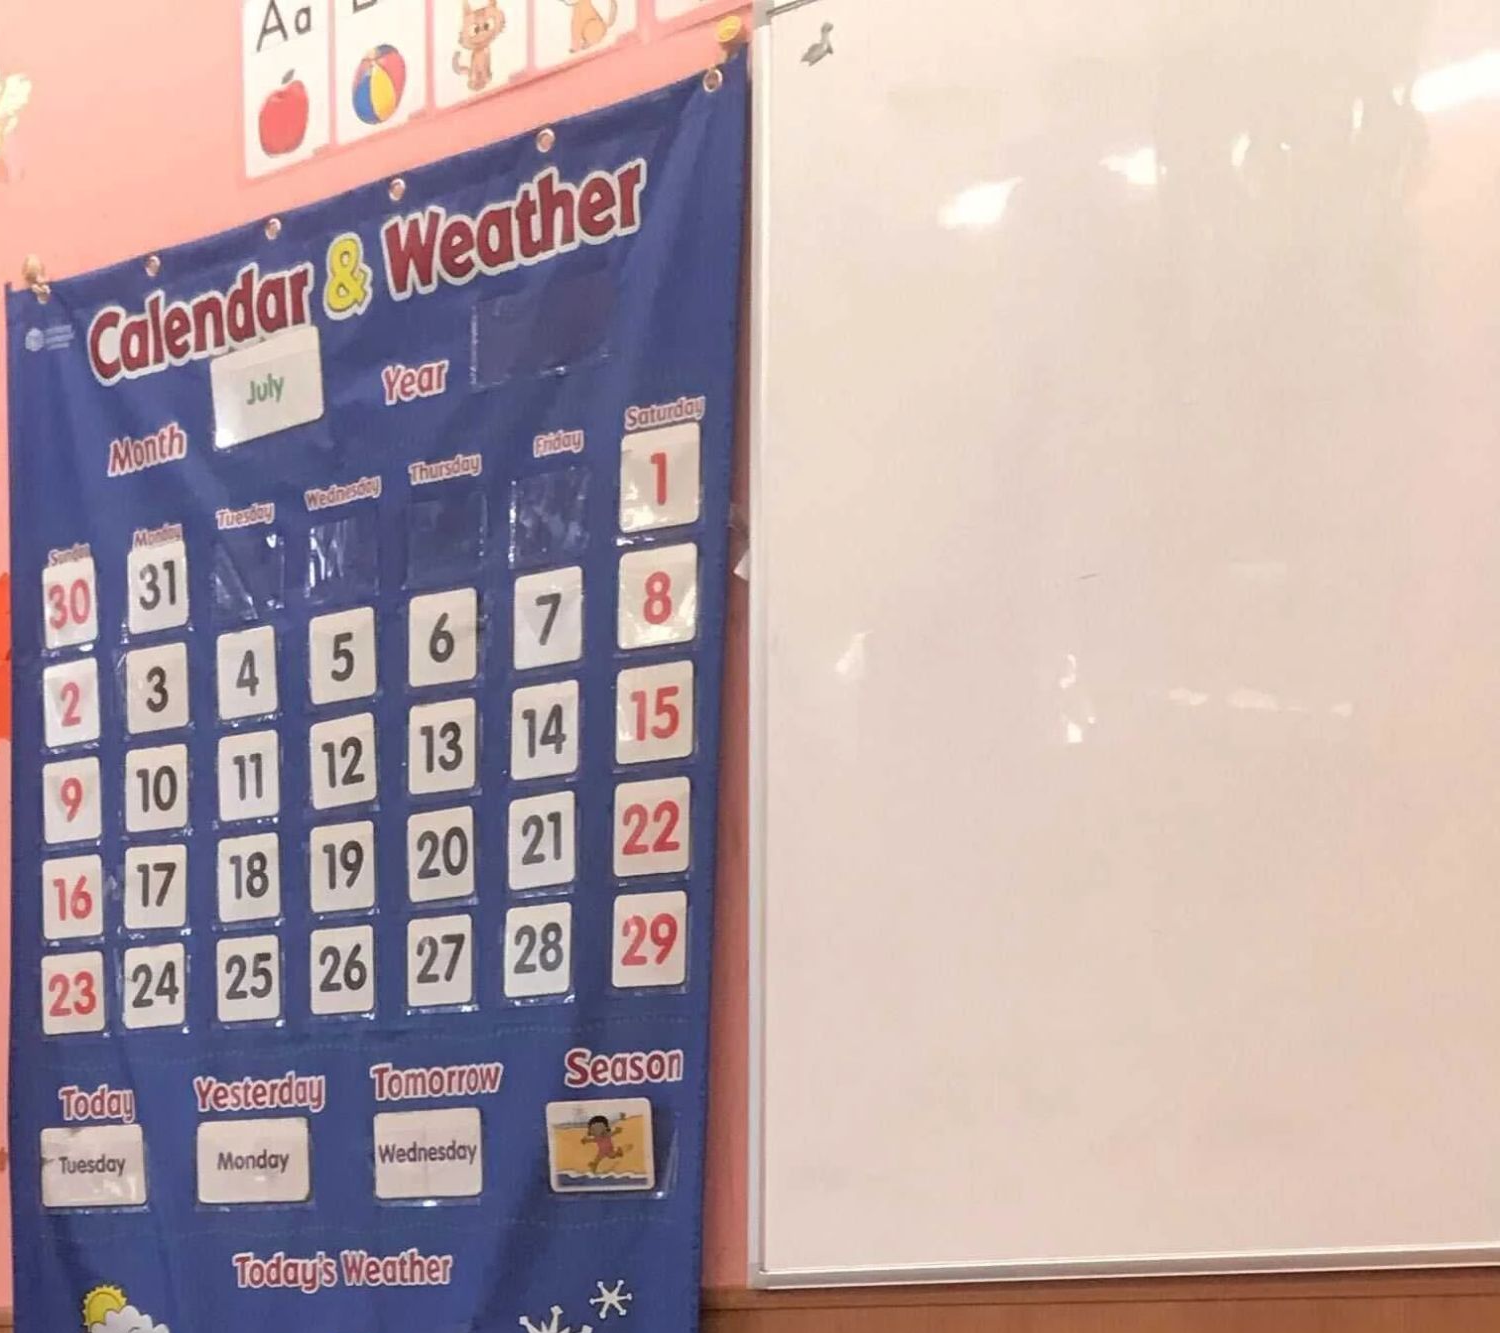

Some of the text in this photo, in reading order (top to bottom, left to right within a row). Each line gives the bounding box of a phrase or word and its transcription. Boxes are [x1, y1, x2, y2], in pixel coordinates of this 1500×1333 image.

[88, 160, 647, 385] Calendar & Weather
[246, 374, 284, 405] July
[382, 360, 449, 404] Year
[108, 426, 185, 477] Month
[216, 502, 274, 530] Tuesday
[305, 476, 382, 511] Wednesday
[409, 454, 481, 485] Thursday
[533, 430, 583, 457] Friday
[625, 395, 706, 430] Saturday
[48, 453, 667, 630] 30 31 1
[60, 572, 672, 726] 2 3 4 5 6 7 8
[61, 686, 679, 821] 9 10 11 12 13 14 15
[54, 801, 680, 920] 16 17 18 19 20 21 22
[49, 913, 677, 1016] 23 24 25 26 27 28 29
[59, 1048, 684, 1123] Today Yesterday Tomorrow Season
[59, 1155, 125, 1176] Tuesday
[217, 1149, 290, 1173] Monday
[378, 1140, 477, 1164] Wednesday
[233, 1249, 453, 1293] Today's Weather
